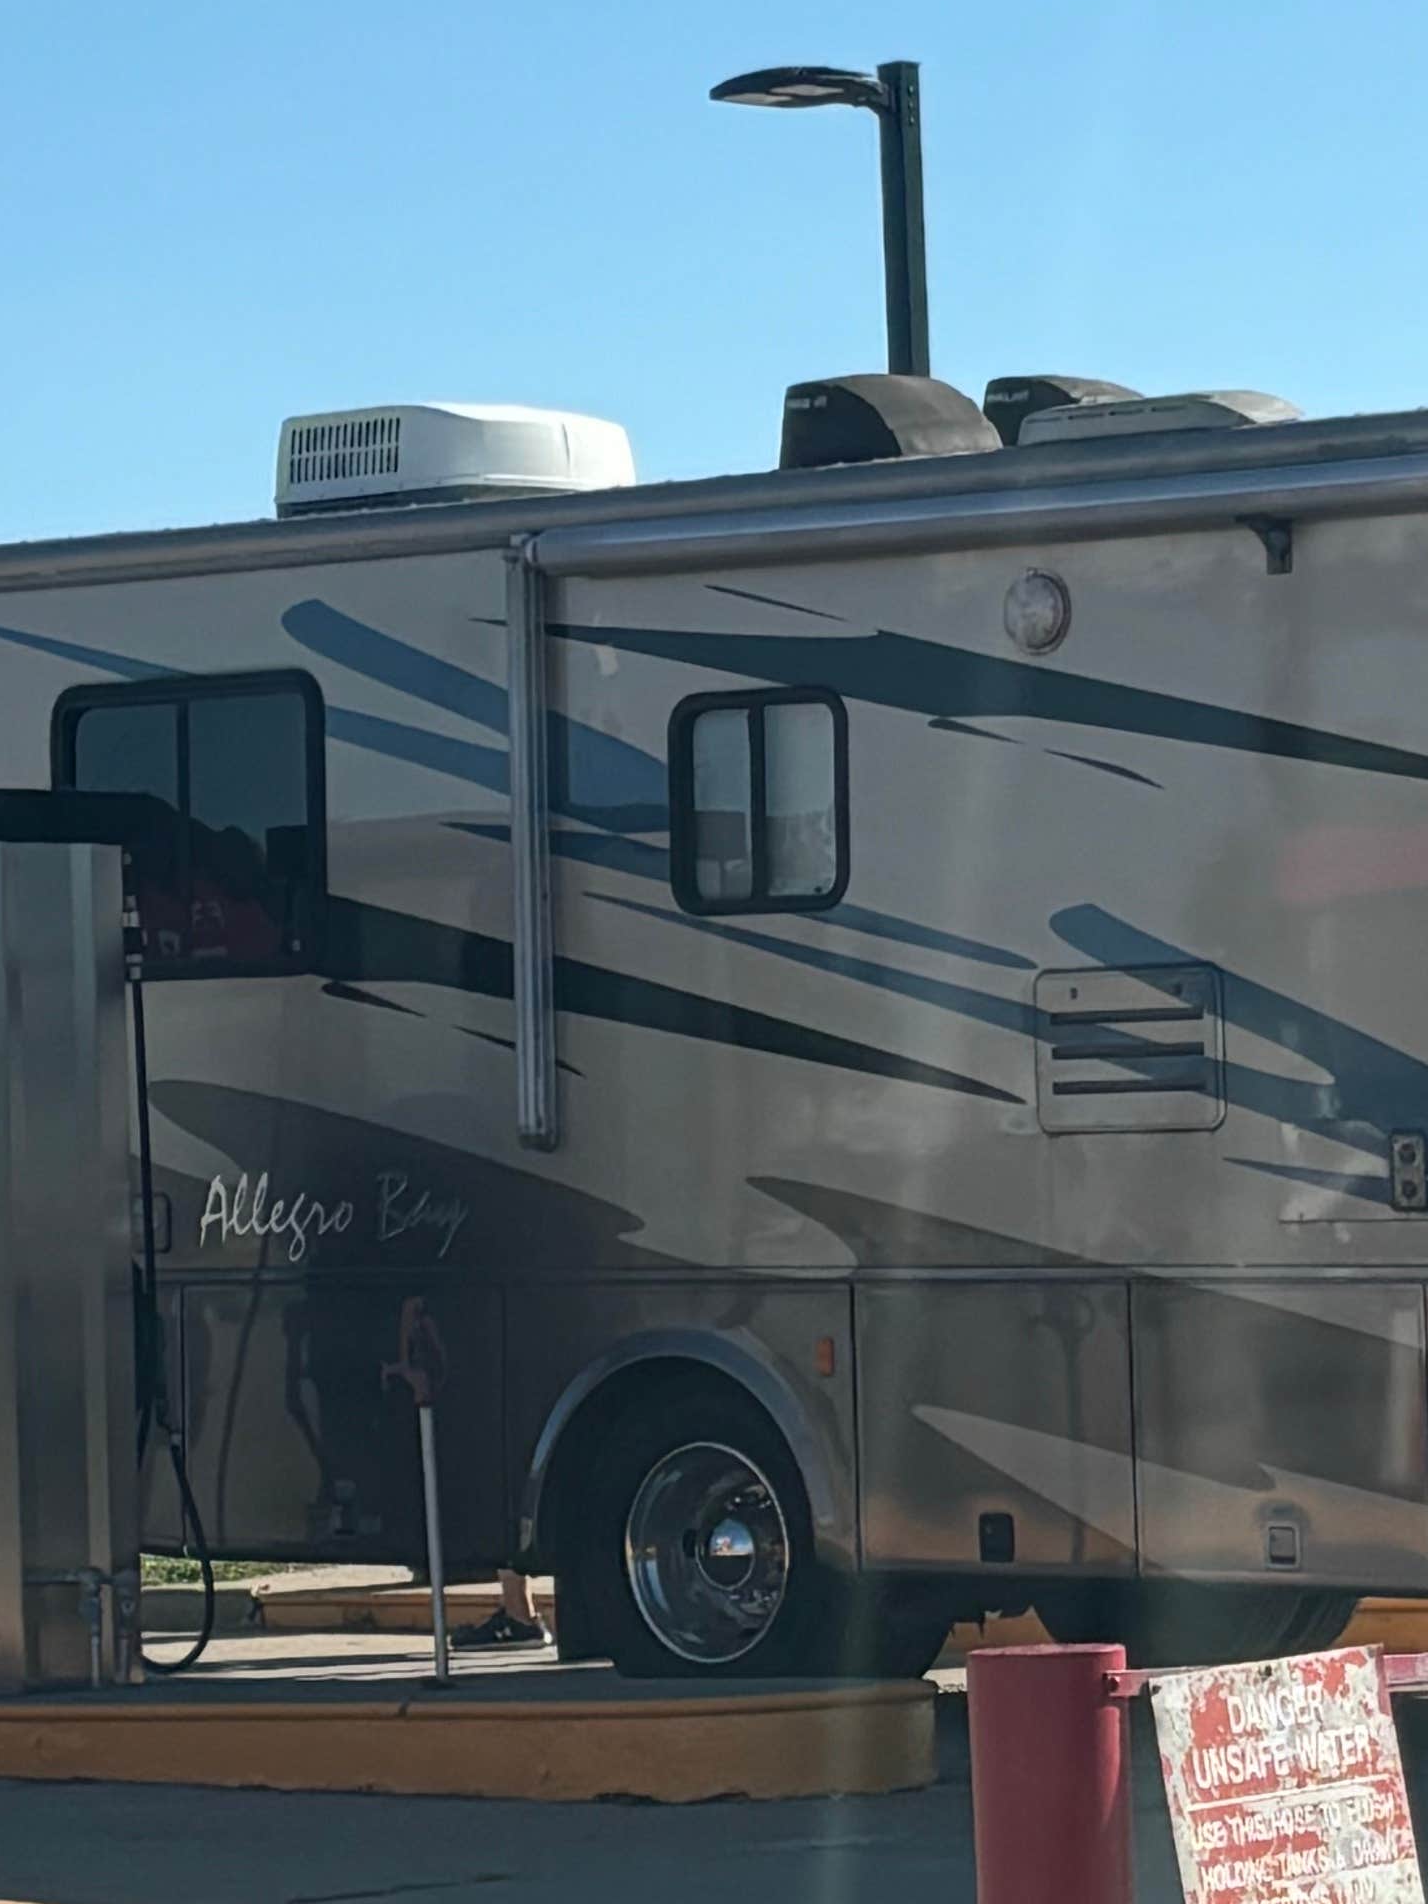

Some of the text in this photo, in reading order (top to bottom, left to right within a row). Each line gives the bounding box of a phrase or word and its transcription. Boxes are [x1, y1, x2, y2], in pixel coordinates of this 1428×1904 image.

[199, 1171, 470, 1263] Allegro Bay
[1227, 1684, 1324, 1734] DANGER
[1192, 1724, 1371, 1789] UNSAFE WATER
[1192, 1822, 1227, 1850] USE
[1226, 1813, 1267, 1846] THIS
[1271, 1804, 1316, 1837] HOSE
[1278, 1846, 1330, 1881] TANKS
